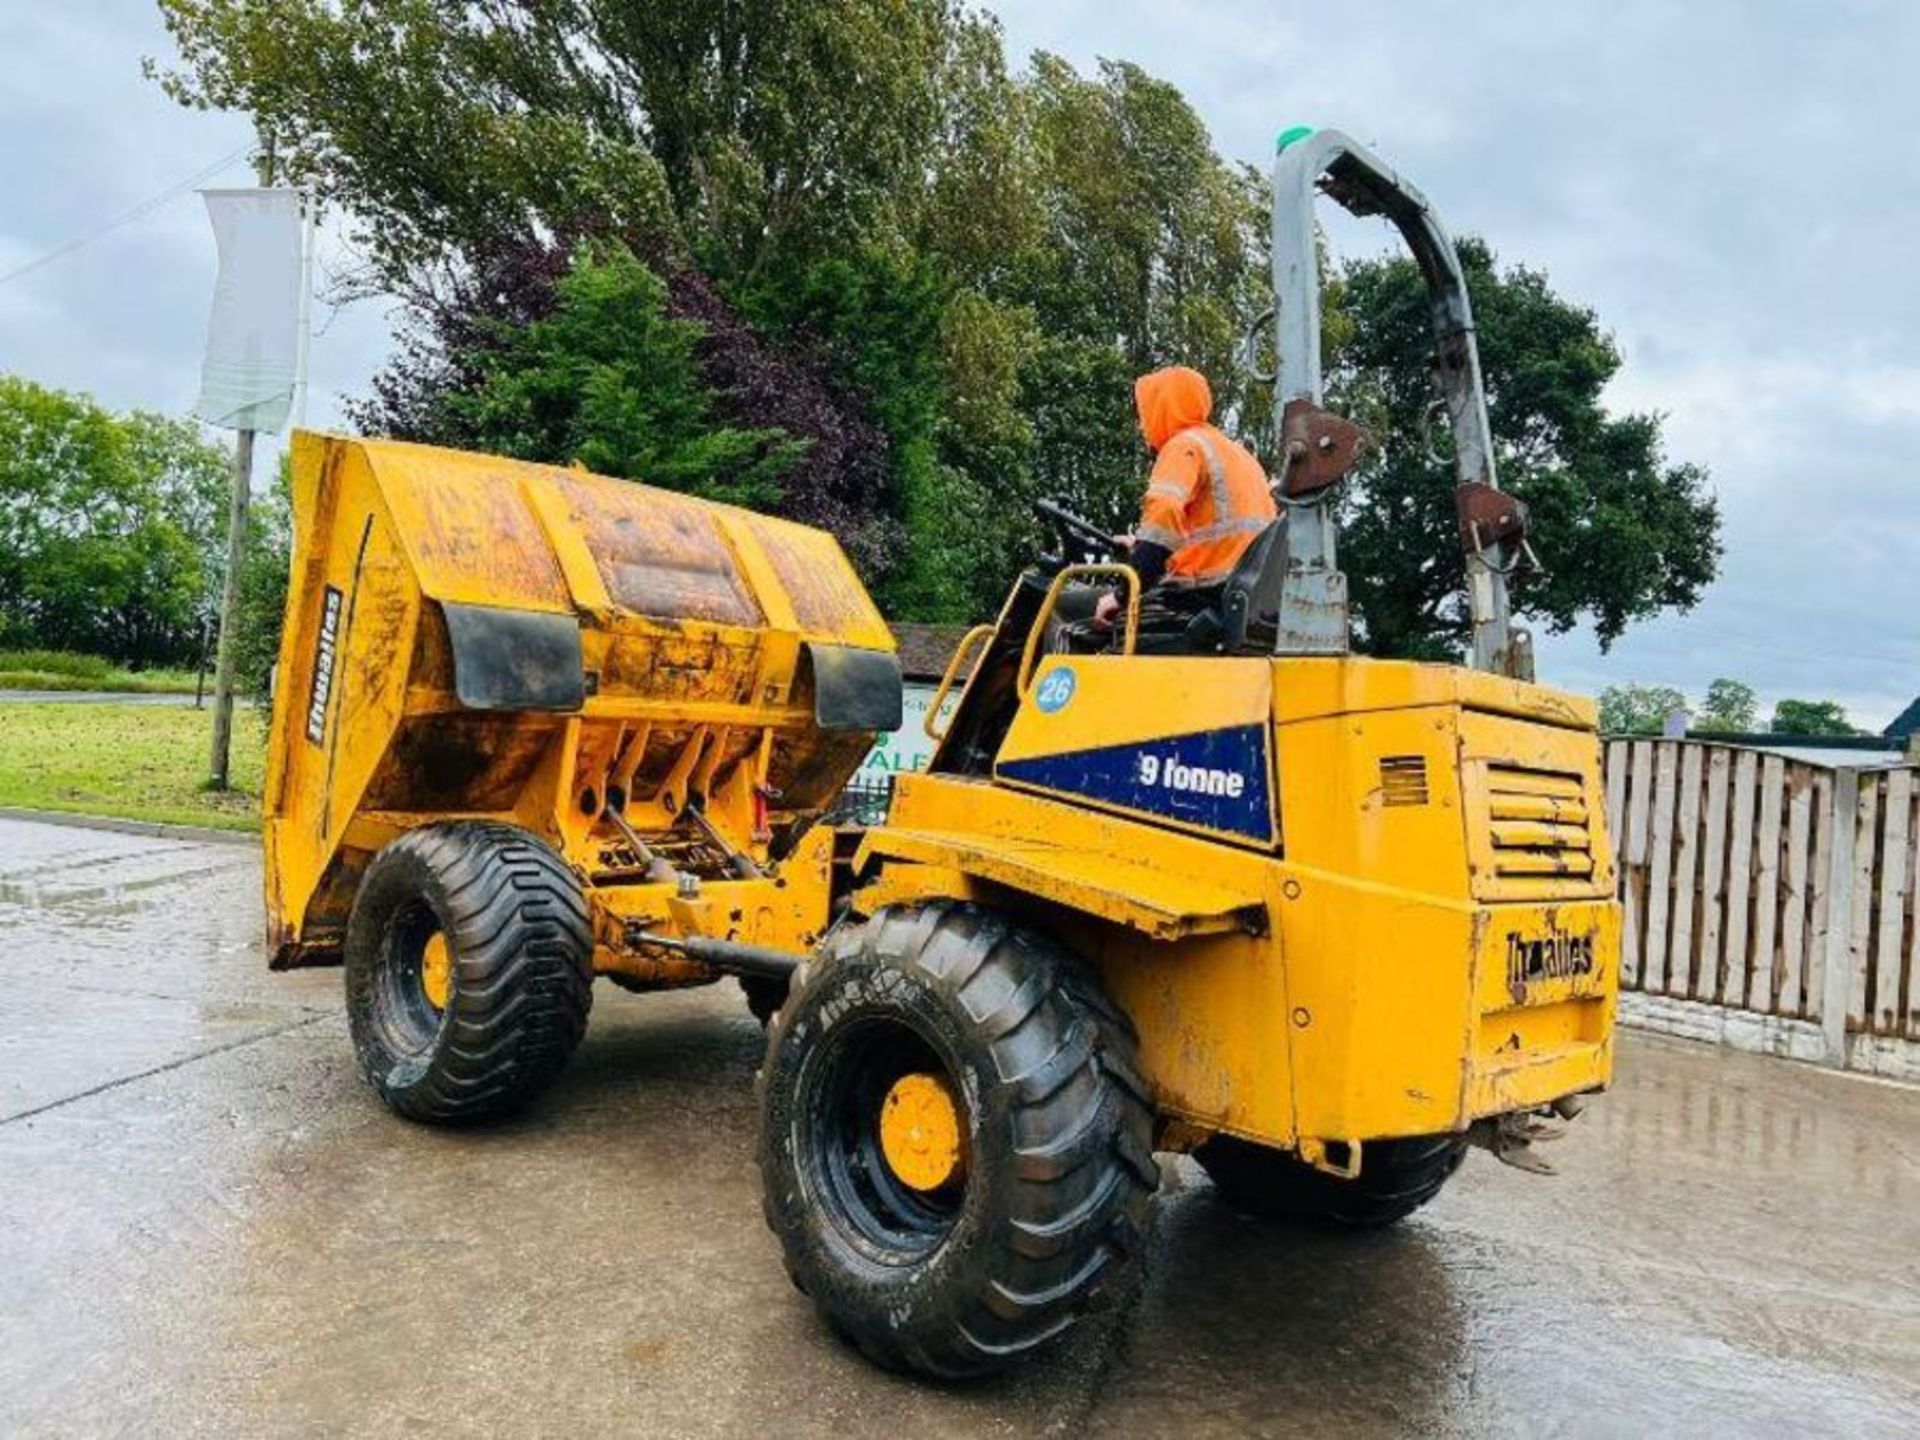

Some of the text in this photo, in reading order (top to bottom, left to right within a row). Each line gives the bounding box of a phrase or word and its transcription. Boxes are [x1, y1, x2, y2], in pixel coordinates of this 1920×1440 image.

[1038, 677, 1071, 702] 26
[1139, 754, 1245, 798] 9 tonne
[1506, 928, 1593, 983] Thaites
